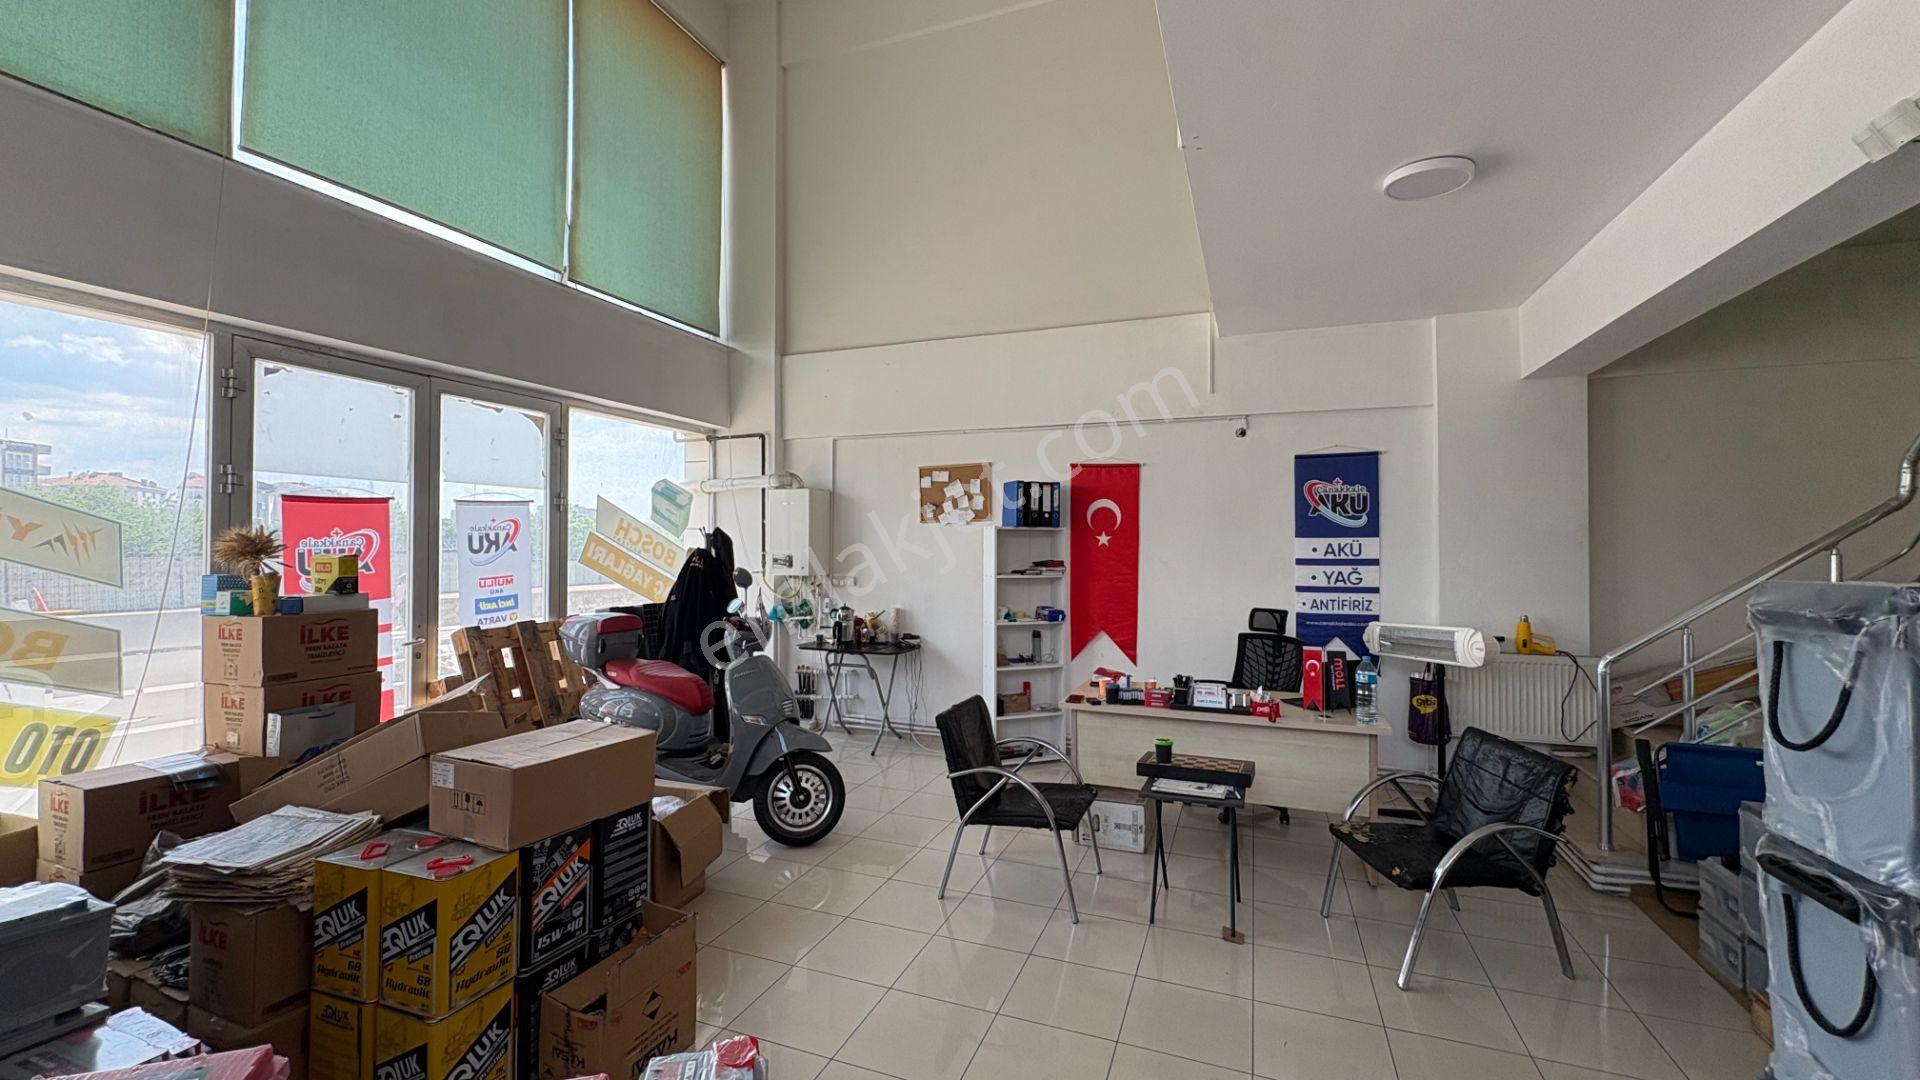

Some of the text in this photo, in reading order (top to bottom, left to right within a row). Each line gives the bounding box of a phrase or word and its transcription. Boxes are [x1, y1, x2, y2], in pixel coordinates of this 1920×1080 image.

[1308, 492, 1370, 517] AKÜ
[1323, 539, 1363, 558] AKÜ
[1323, 567, 1364, 586] YAĞ
[1309, 595, 1374, 612] ANTİFİRİZ
[218, 623, 243, 641] İLKE
[299, 624, 350, 646] İLKE
[220, 693, 246, 711] İLKE
[537, 916, 584, 950] 15W-40
[385, 978, 431, 999] Hydraulic
